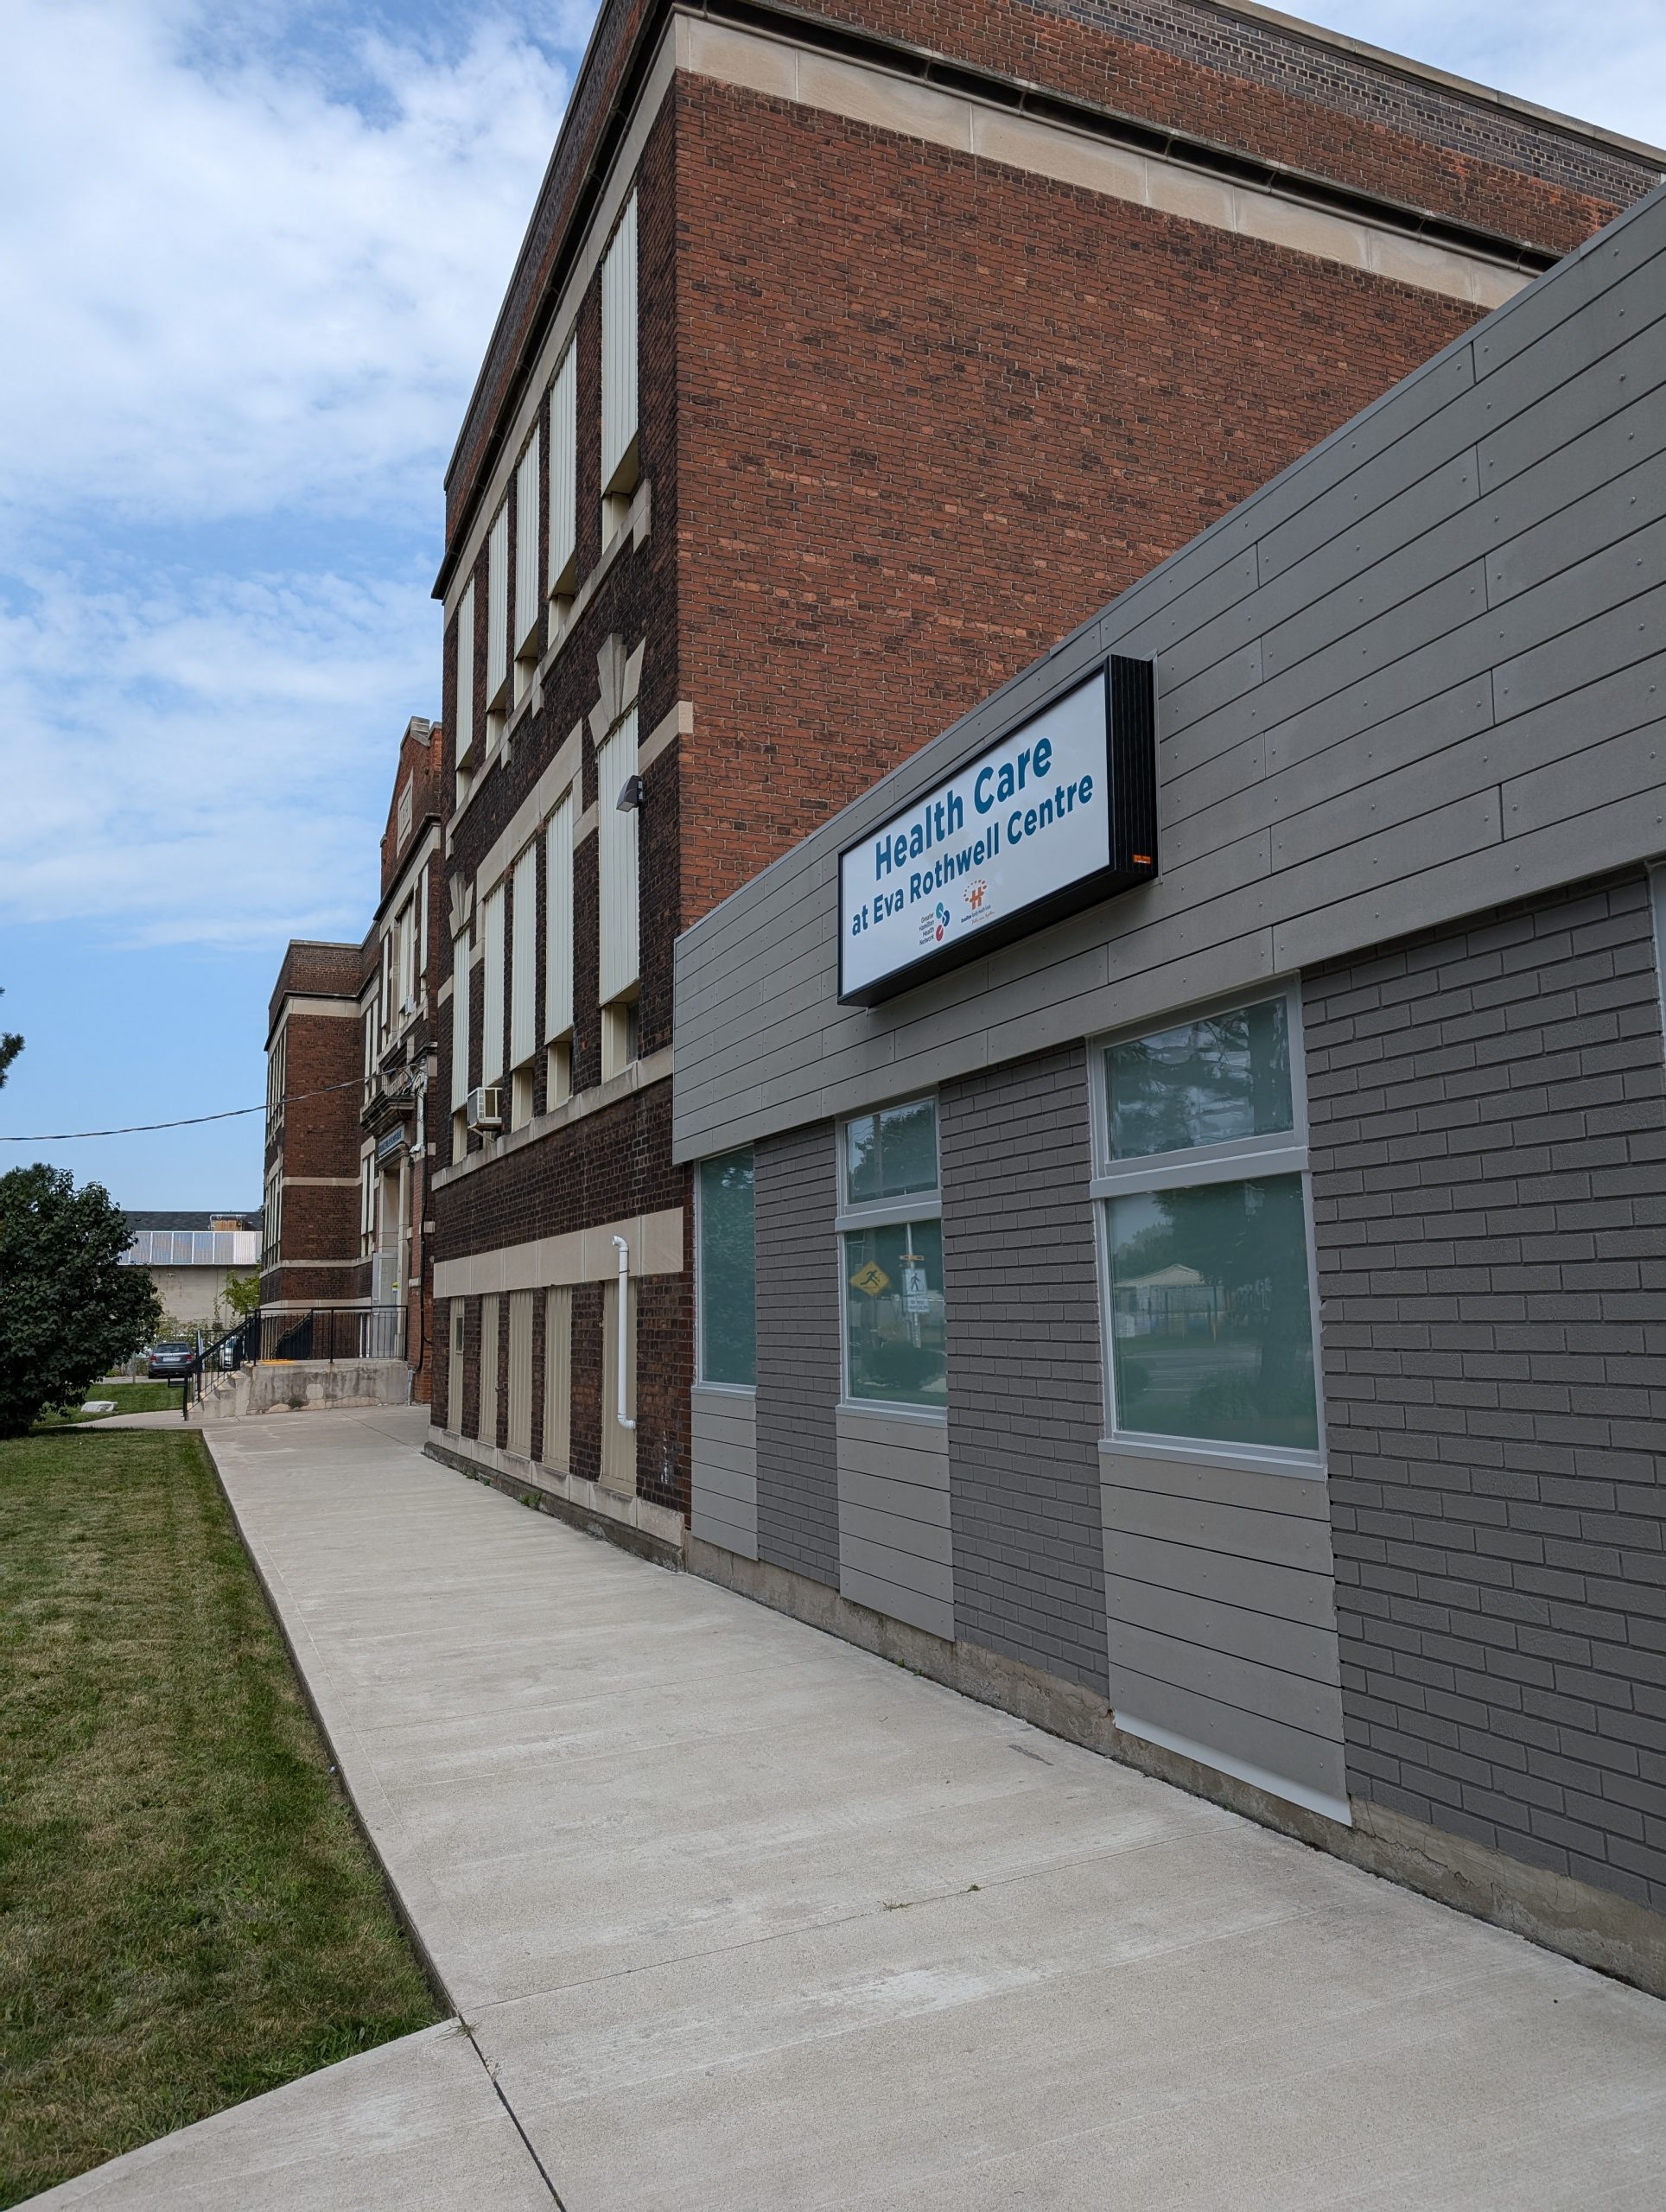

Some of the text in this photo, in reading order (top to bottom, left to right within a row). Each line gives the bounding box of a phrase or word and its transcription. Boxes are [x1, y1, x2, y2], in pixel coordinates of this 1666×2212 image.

[875, 738, 1052, 880] Health Care
[852, 775, 1093, 936] at Eva Rothwell Centre
[921, 912, 934, 923] Greater
[922, 926, 934, 937] Health
[919, 934, 934, 946] Network
